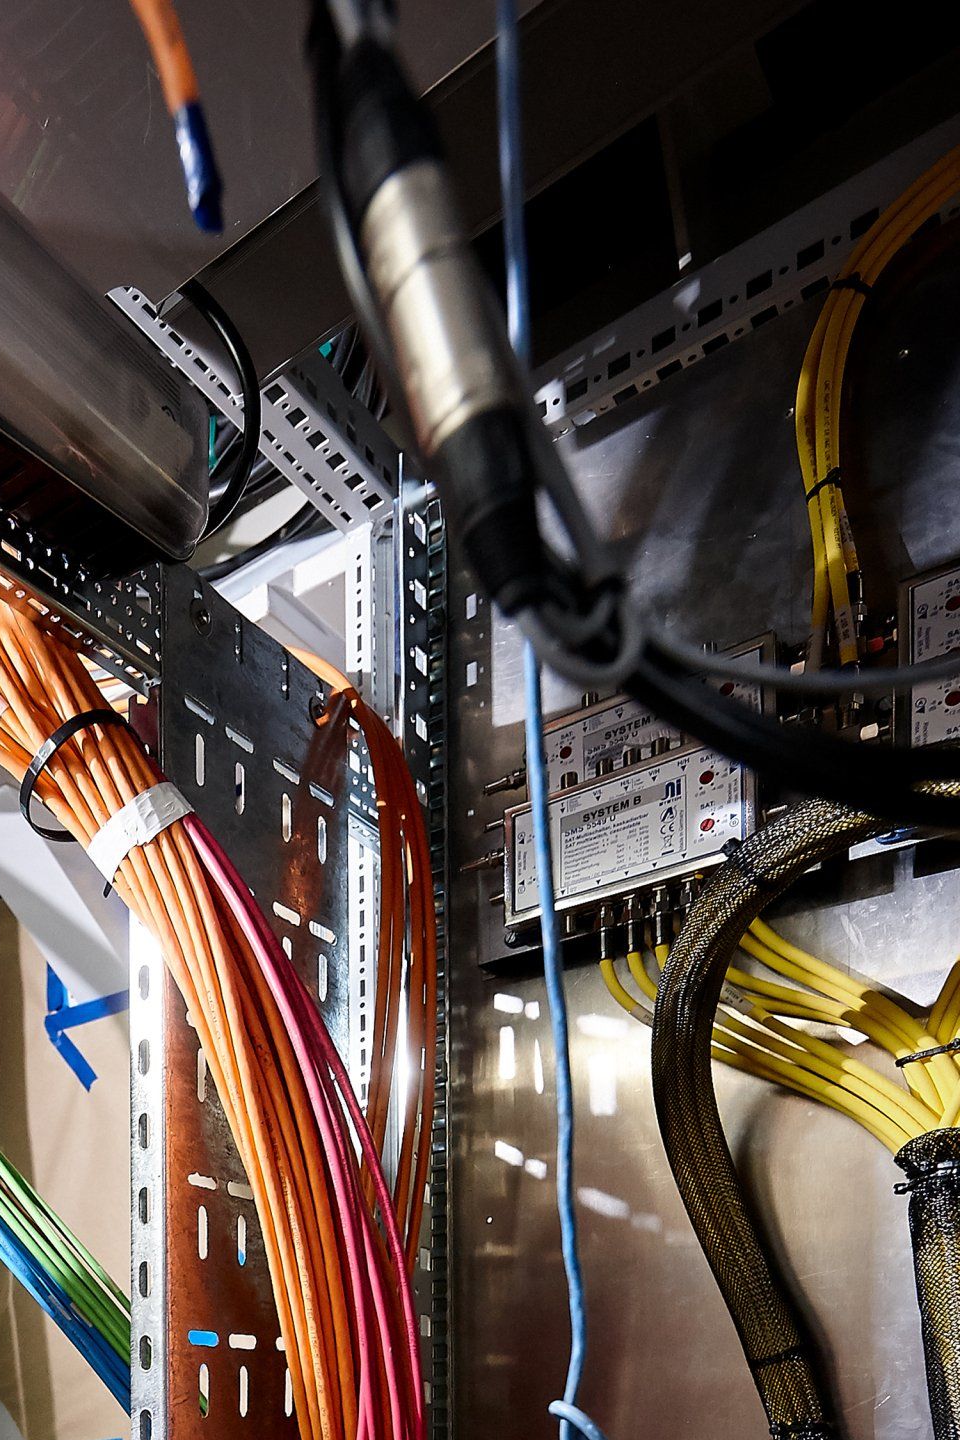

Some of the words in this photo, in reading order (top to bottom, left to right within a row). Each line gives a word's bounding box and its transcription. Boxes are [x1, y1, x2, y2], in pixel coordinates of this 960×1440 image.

[604, 715, 651, 740] SYSTEM
[582, 799, 630, 823] SYSTEM
[633, 795, 642, 806] B
